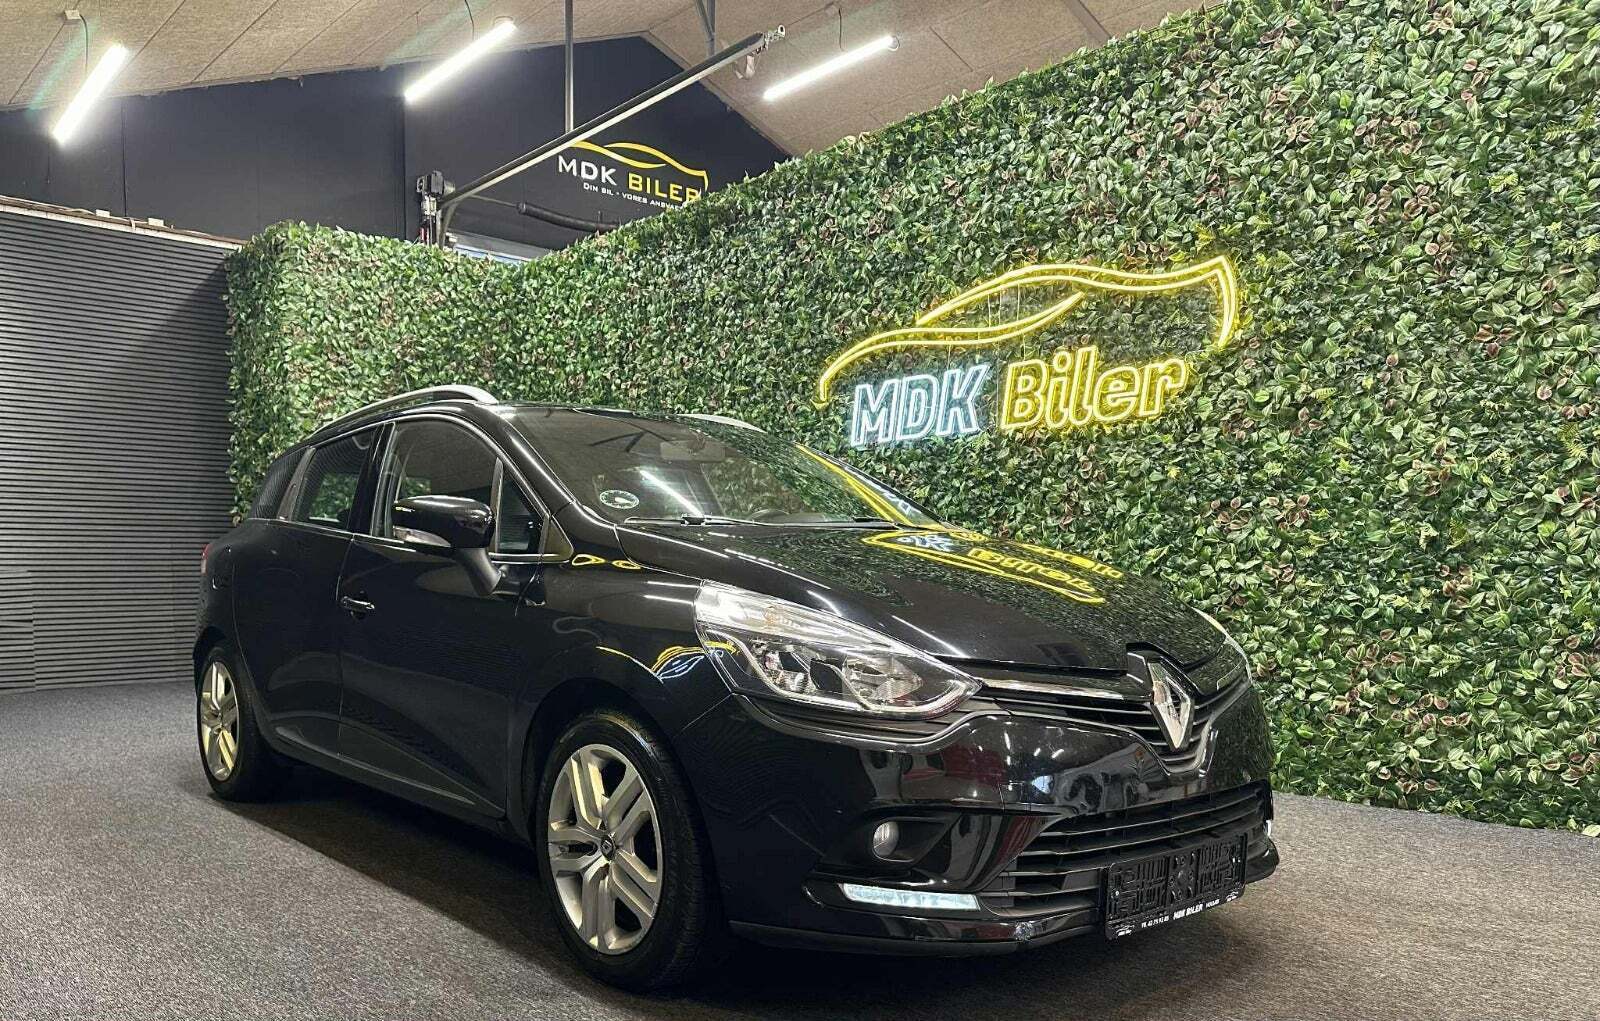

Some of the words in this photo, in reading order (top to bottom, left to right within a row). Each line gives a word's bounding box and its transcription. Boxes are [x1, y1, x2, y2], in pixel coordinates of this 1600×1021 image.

[558, 155, 617, 186] MDK
[628, 172, 702, 203] BILER
[851, 363, 991, 447] MDK
[1001, 345, 1189, 431] Biler
